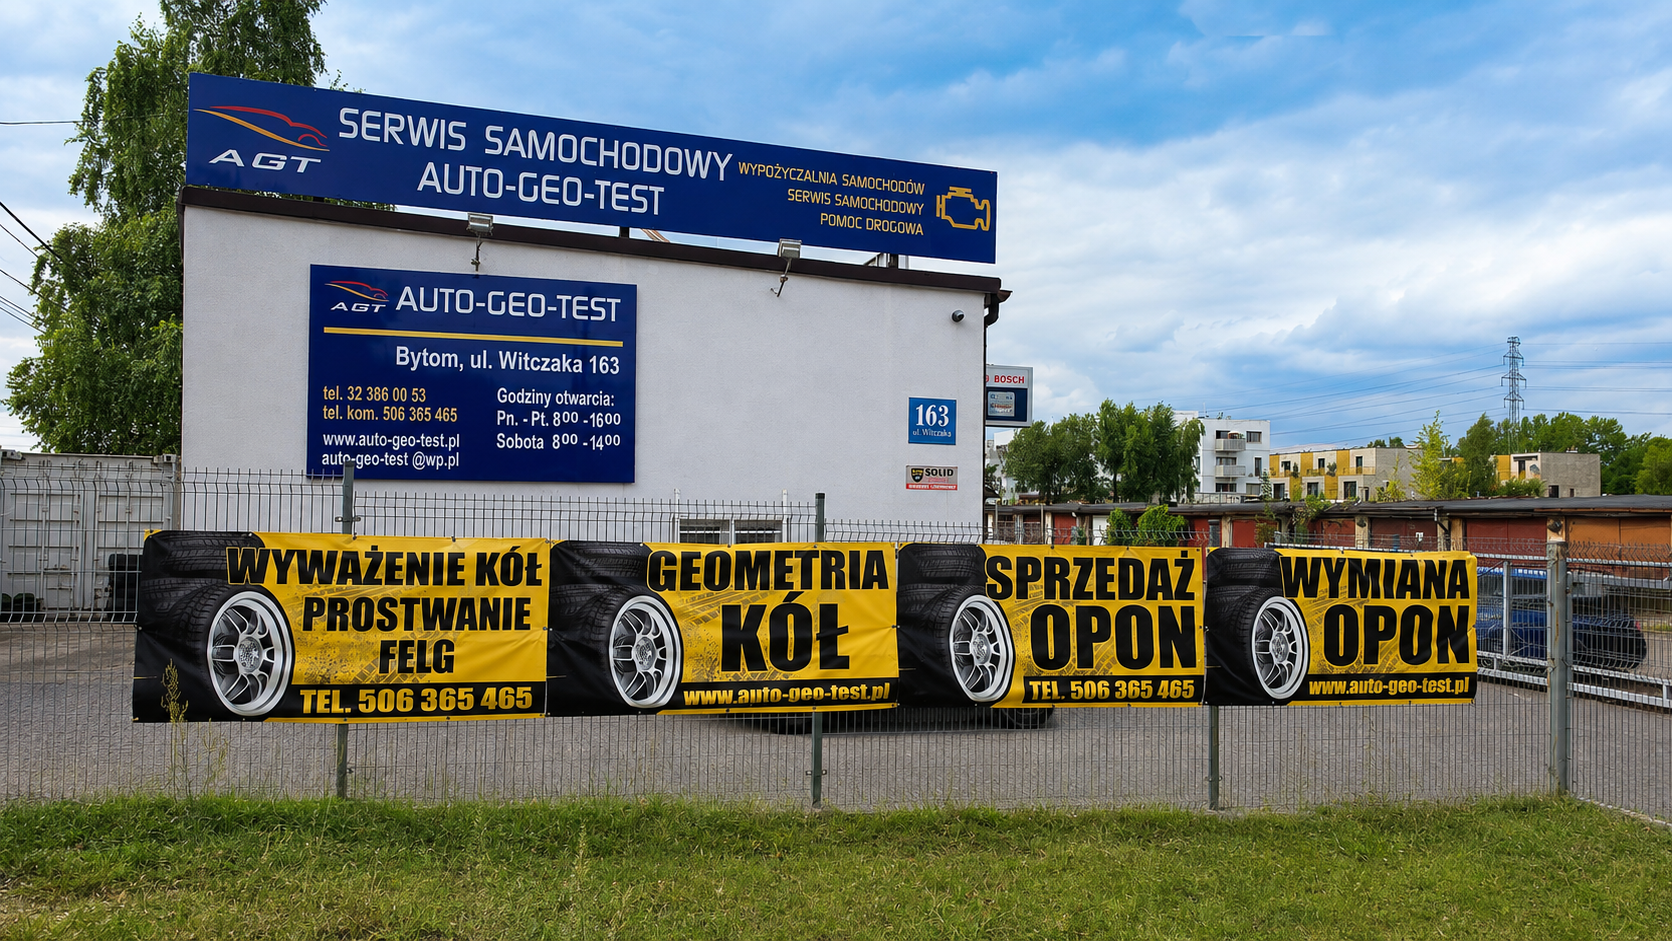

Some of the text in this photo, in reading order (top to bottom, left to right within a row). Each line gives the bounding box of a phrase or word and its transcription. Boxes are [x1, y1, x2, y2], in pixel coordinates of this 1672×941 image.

[339, 107, 733, 182] SERWIS SAMOCHODOWY
[209, 149, 322, 174] AGT
[417, 161, 665, 216] AUTO-GEO-TEST
[738, 161, 925, 196] WYPOŻYCZALNIA SAMOCHODÓW
[787, 188, 924, 216] SERWIS SAMOCHODOWY
[820, 212, 924, 236] POMOC DROGOWA
[330, 301, 390, 313] AGT
[395, 286, 621, 322] AUTO-GEO-TEST
[396, 346, 620, 375] Bytom, ul. Witczaka 163
[994, 375, 1025, 384] BOSCH
[323, 385, 426, 403] tel. 32 386 00 53
[497, 387, 615, 408] Godziny otwarcia:
[323, 405, 458, 423] tel. kom. 506 365 465
[497, 410, 518, 426] Pn.
[532, 411, 549, 427] Pt.
[916, 404, 950, 427] 163
[323, 433, 460, 451] www.auto-geo-test.pl
[496, 433, 544, 449] Sobota
[412, 451, 460, 470] @wp.pl
[925, 468, 954, 477] SOLID
[226, 545, 543, 587] WYWAŻENIE KÓŁ
[649, 550, 889, 591] GEOMETRIA
[986, 550, 1195, 601] SPRZEDAŻ
[1280, 556, 1470, 599] WYMIANA
[303, 597, 531, 632] PROSTWANIE
[721, 591, 850, 673] KÓŁ
[1030, 604, 1197, 670] OPON
[1323, 604, 1470, 666] OPON
[378, 640, 455, 674] FELG
[683, 682, 890, 706] www.auto-geo-test.pl
[1029, 680, 1194, 700] TEL. 506 365 465
[1308, 676, 1470, 695] www.auto-geo-test.pl
[300, 687, 532, 714] TEL. 506 365 465
